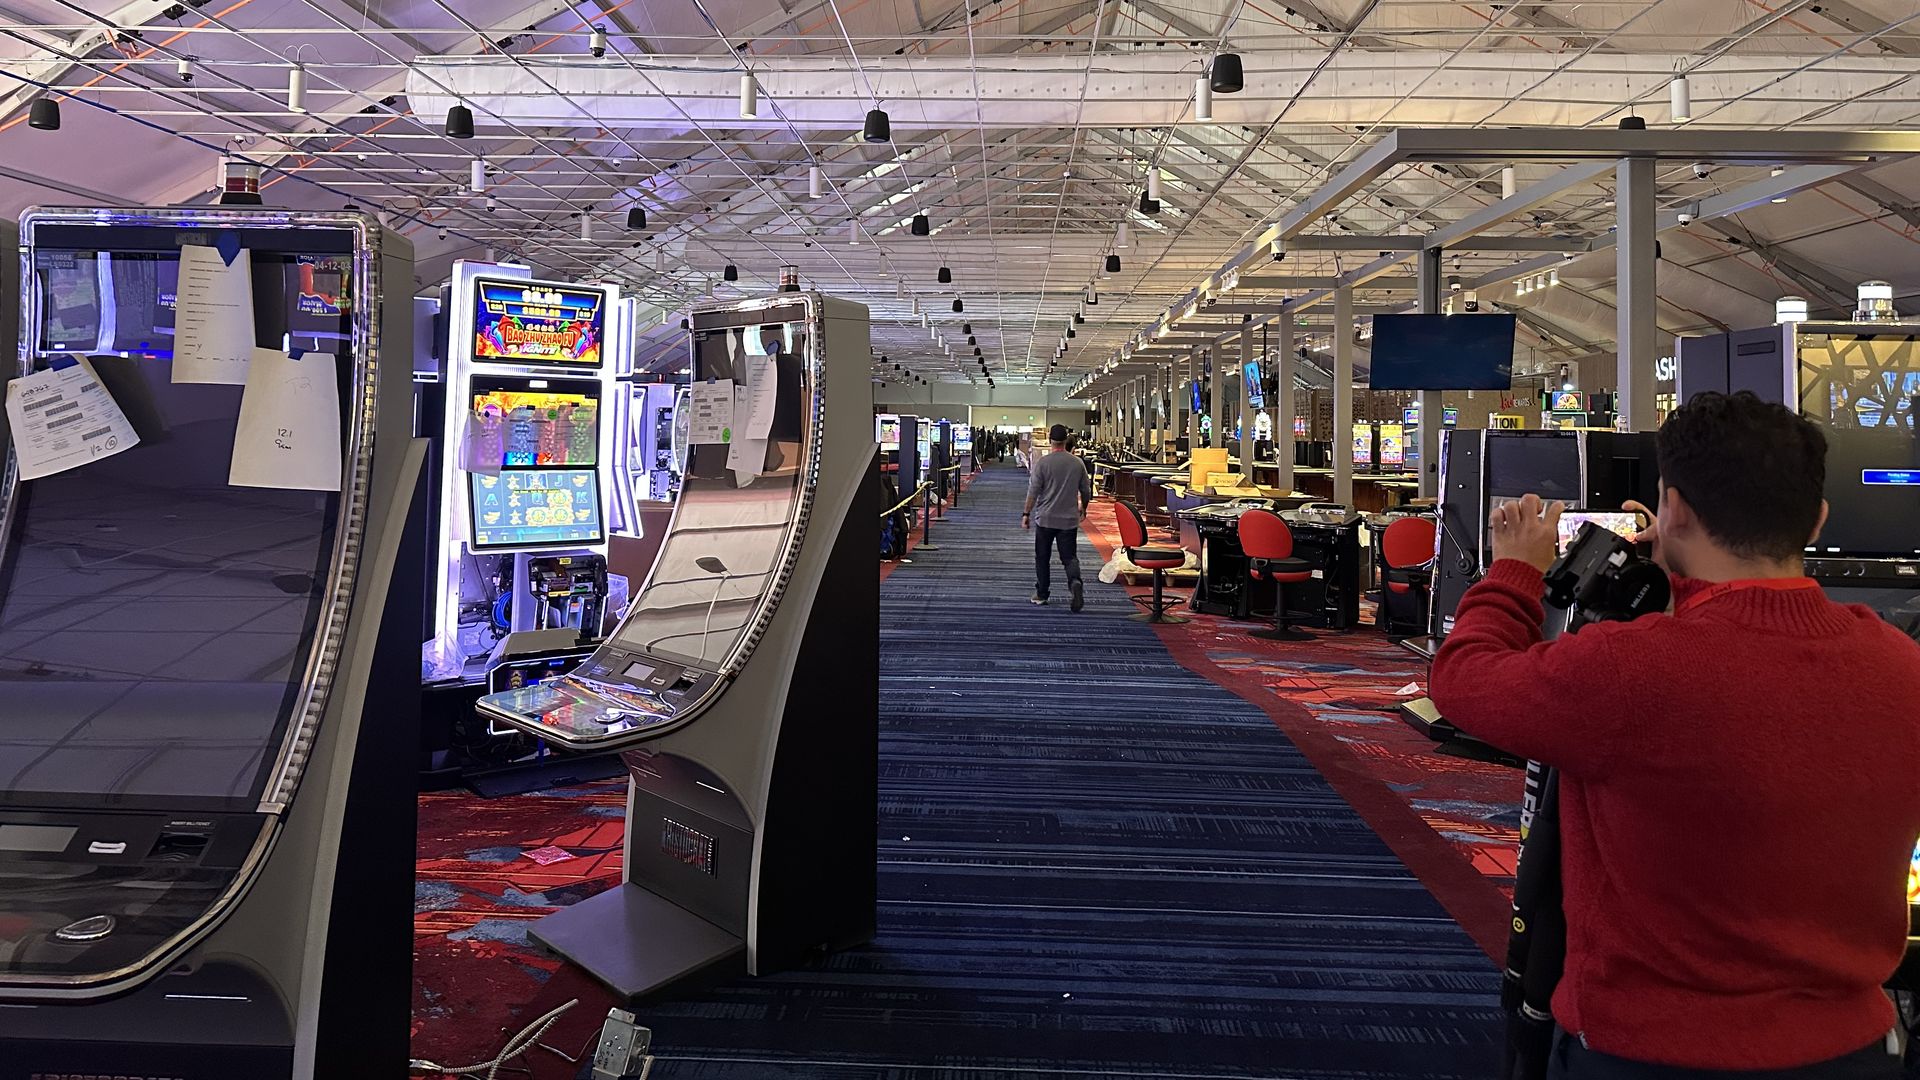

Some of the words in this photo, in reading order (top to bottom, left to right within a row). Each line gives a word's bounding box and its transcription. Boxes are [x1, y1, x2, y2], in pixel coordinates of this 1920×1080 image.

[506, 326, 524, 343] BAO
[524, 330, 541, 344] ZHU
[541, 332, 562, 346] ZHAO
[563, 332, 574, 347] FU
[522, 343, 559, 355] IGNITE
[1630, 585, 1649, 609] MILLER
